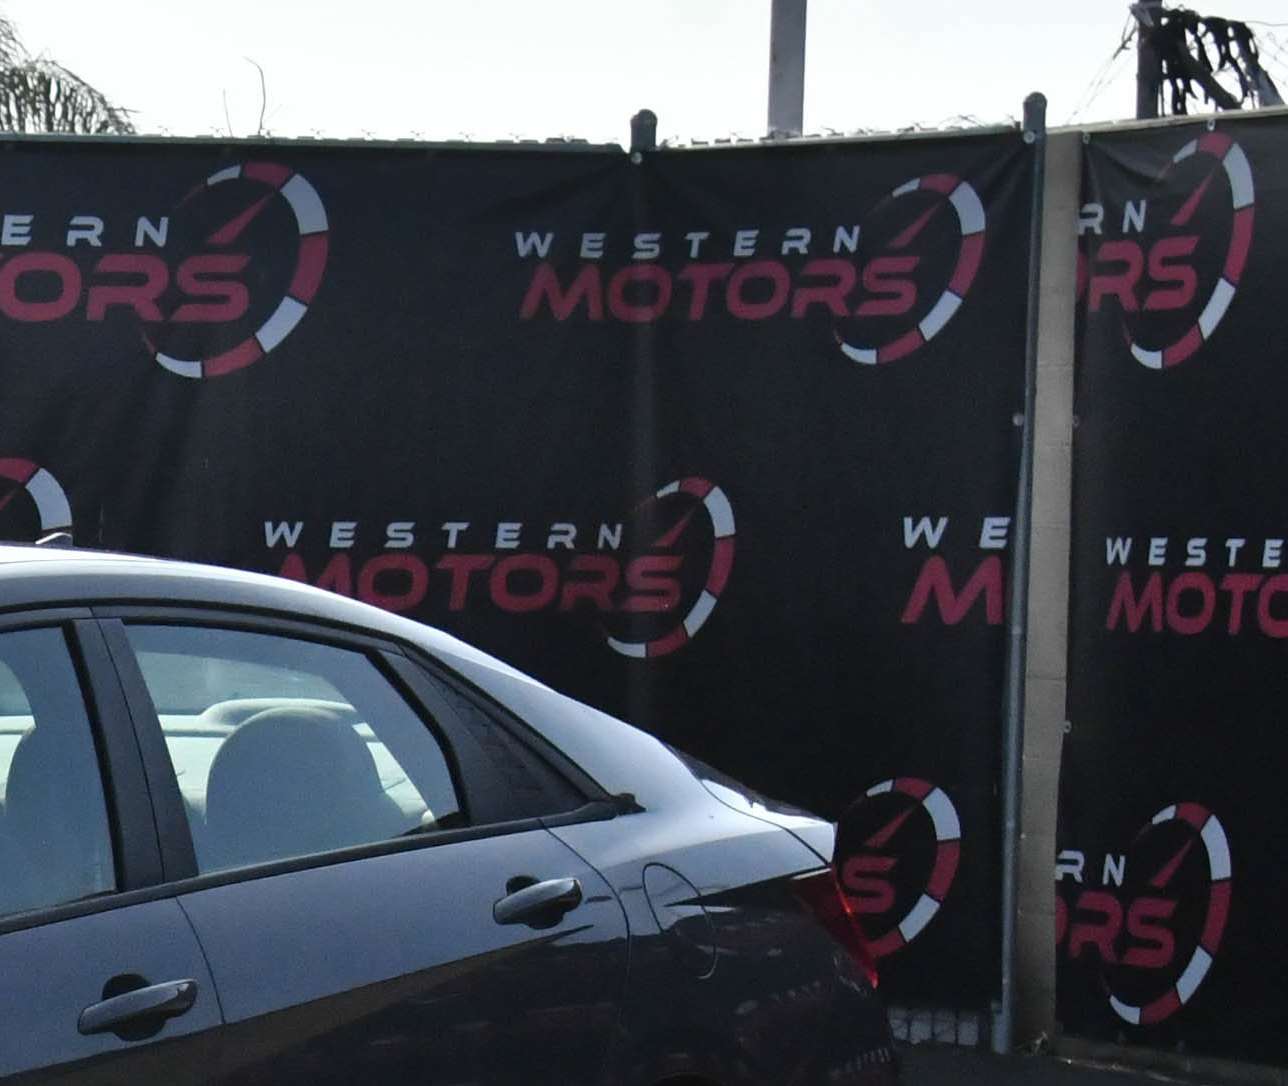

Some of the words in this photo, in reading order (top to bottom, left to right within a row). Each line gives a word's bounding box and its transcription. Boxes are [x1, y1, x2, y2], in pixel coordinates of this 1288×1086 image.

[515, 226, 861, 259] WESTERN
[1078, 235, 1200, 312] RS
[520, 256, 921, 322] MOTORS
[264, 521, 622, 549] WESTERN
[1056, 890, 1177, 969] RS
